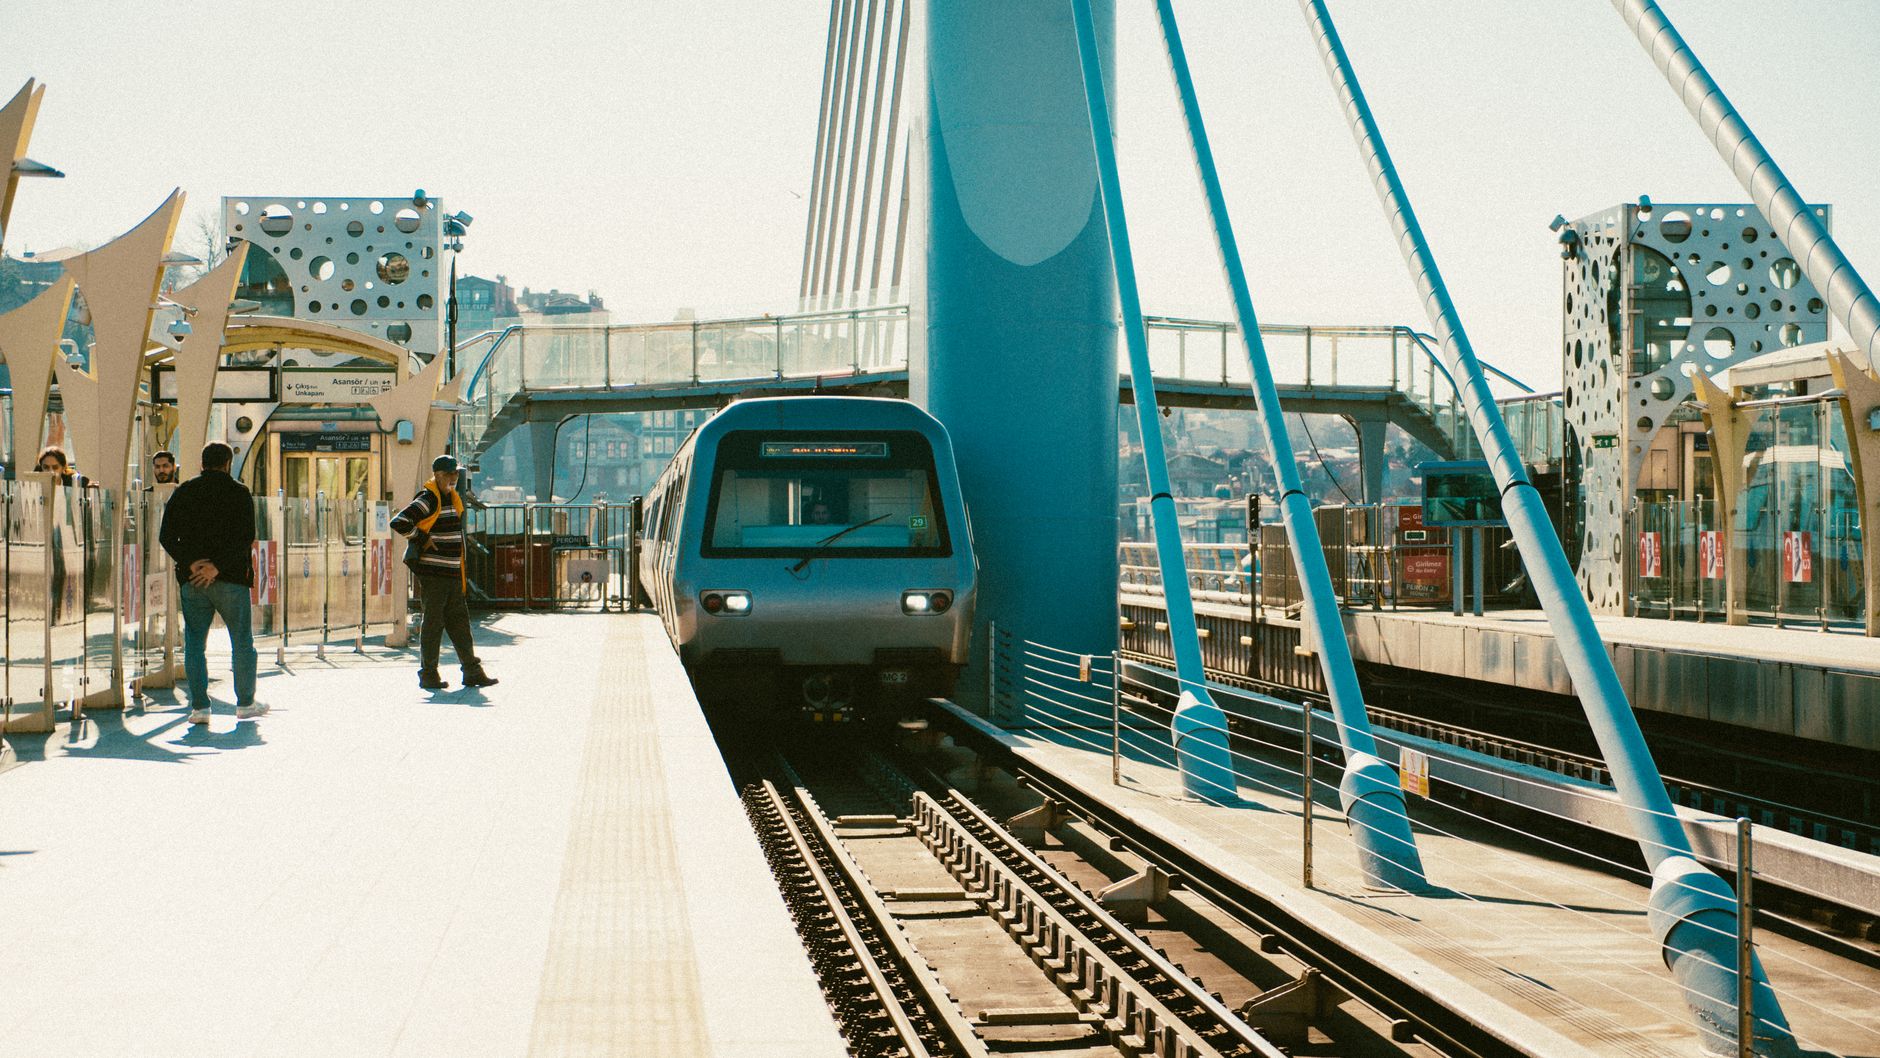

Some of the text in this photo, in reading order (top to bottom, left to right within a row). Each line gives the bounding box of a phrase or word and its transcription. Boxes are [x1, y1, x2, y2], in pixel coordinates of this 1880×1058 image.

[912, 518, 924, 527] 29
[556, 536, 577, 544] PERON
[1406, 583, 1429, 591] PERON
[883, 672, 906, 681] MC 2
